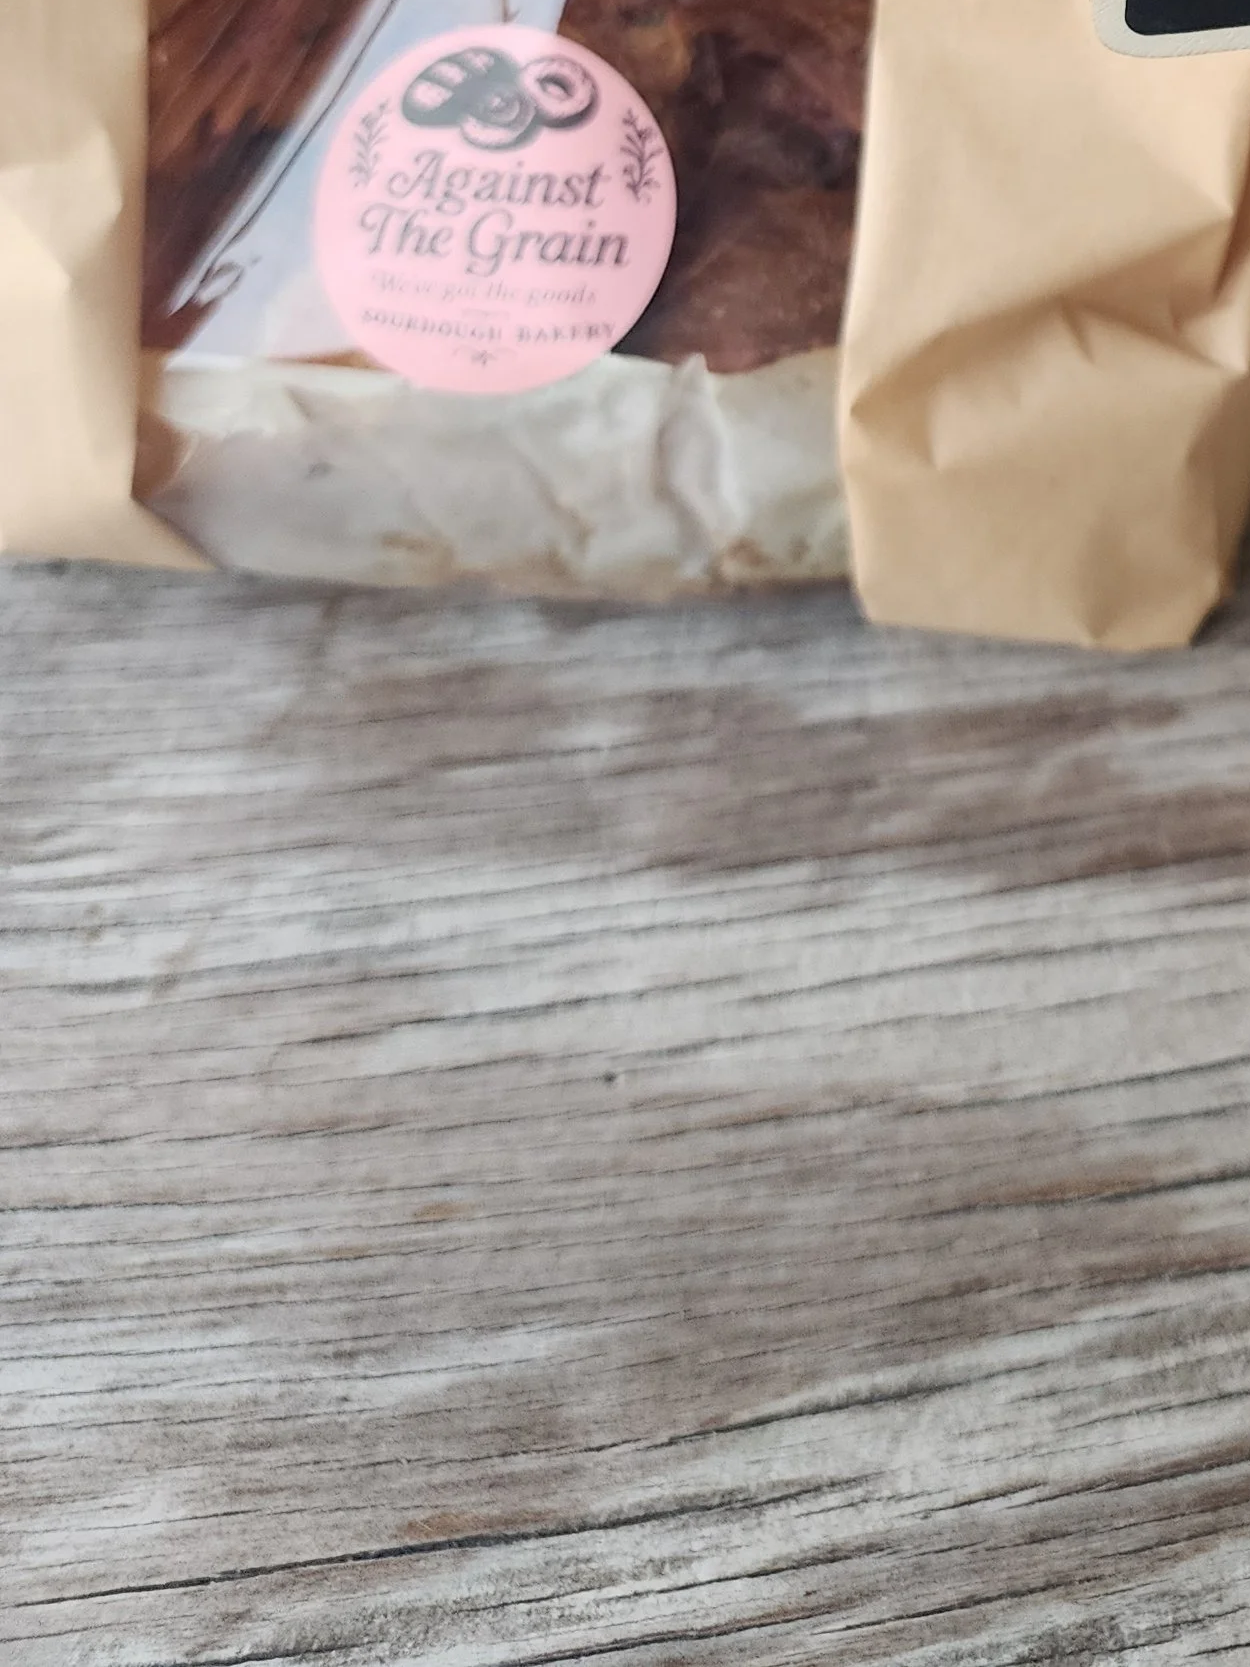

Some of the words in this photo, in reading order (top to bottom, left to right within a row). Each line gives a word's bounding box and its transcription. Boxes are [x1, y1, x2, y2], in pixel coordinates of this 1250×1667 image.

[388, 149, 611, 215] Against
[358, 203, 452, 256] The
[464, 209, 630, 277] Grain
[485, 280, 516, 301] the
[526, 283, 597, 310] goods
[360, 308, 503, 342] SOURDOUGH
[516, 321, 616, 344] BAKERY
